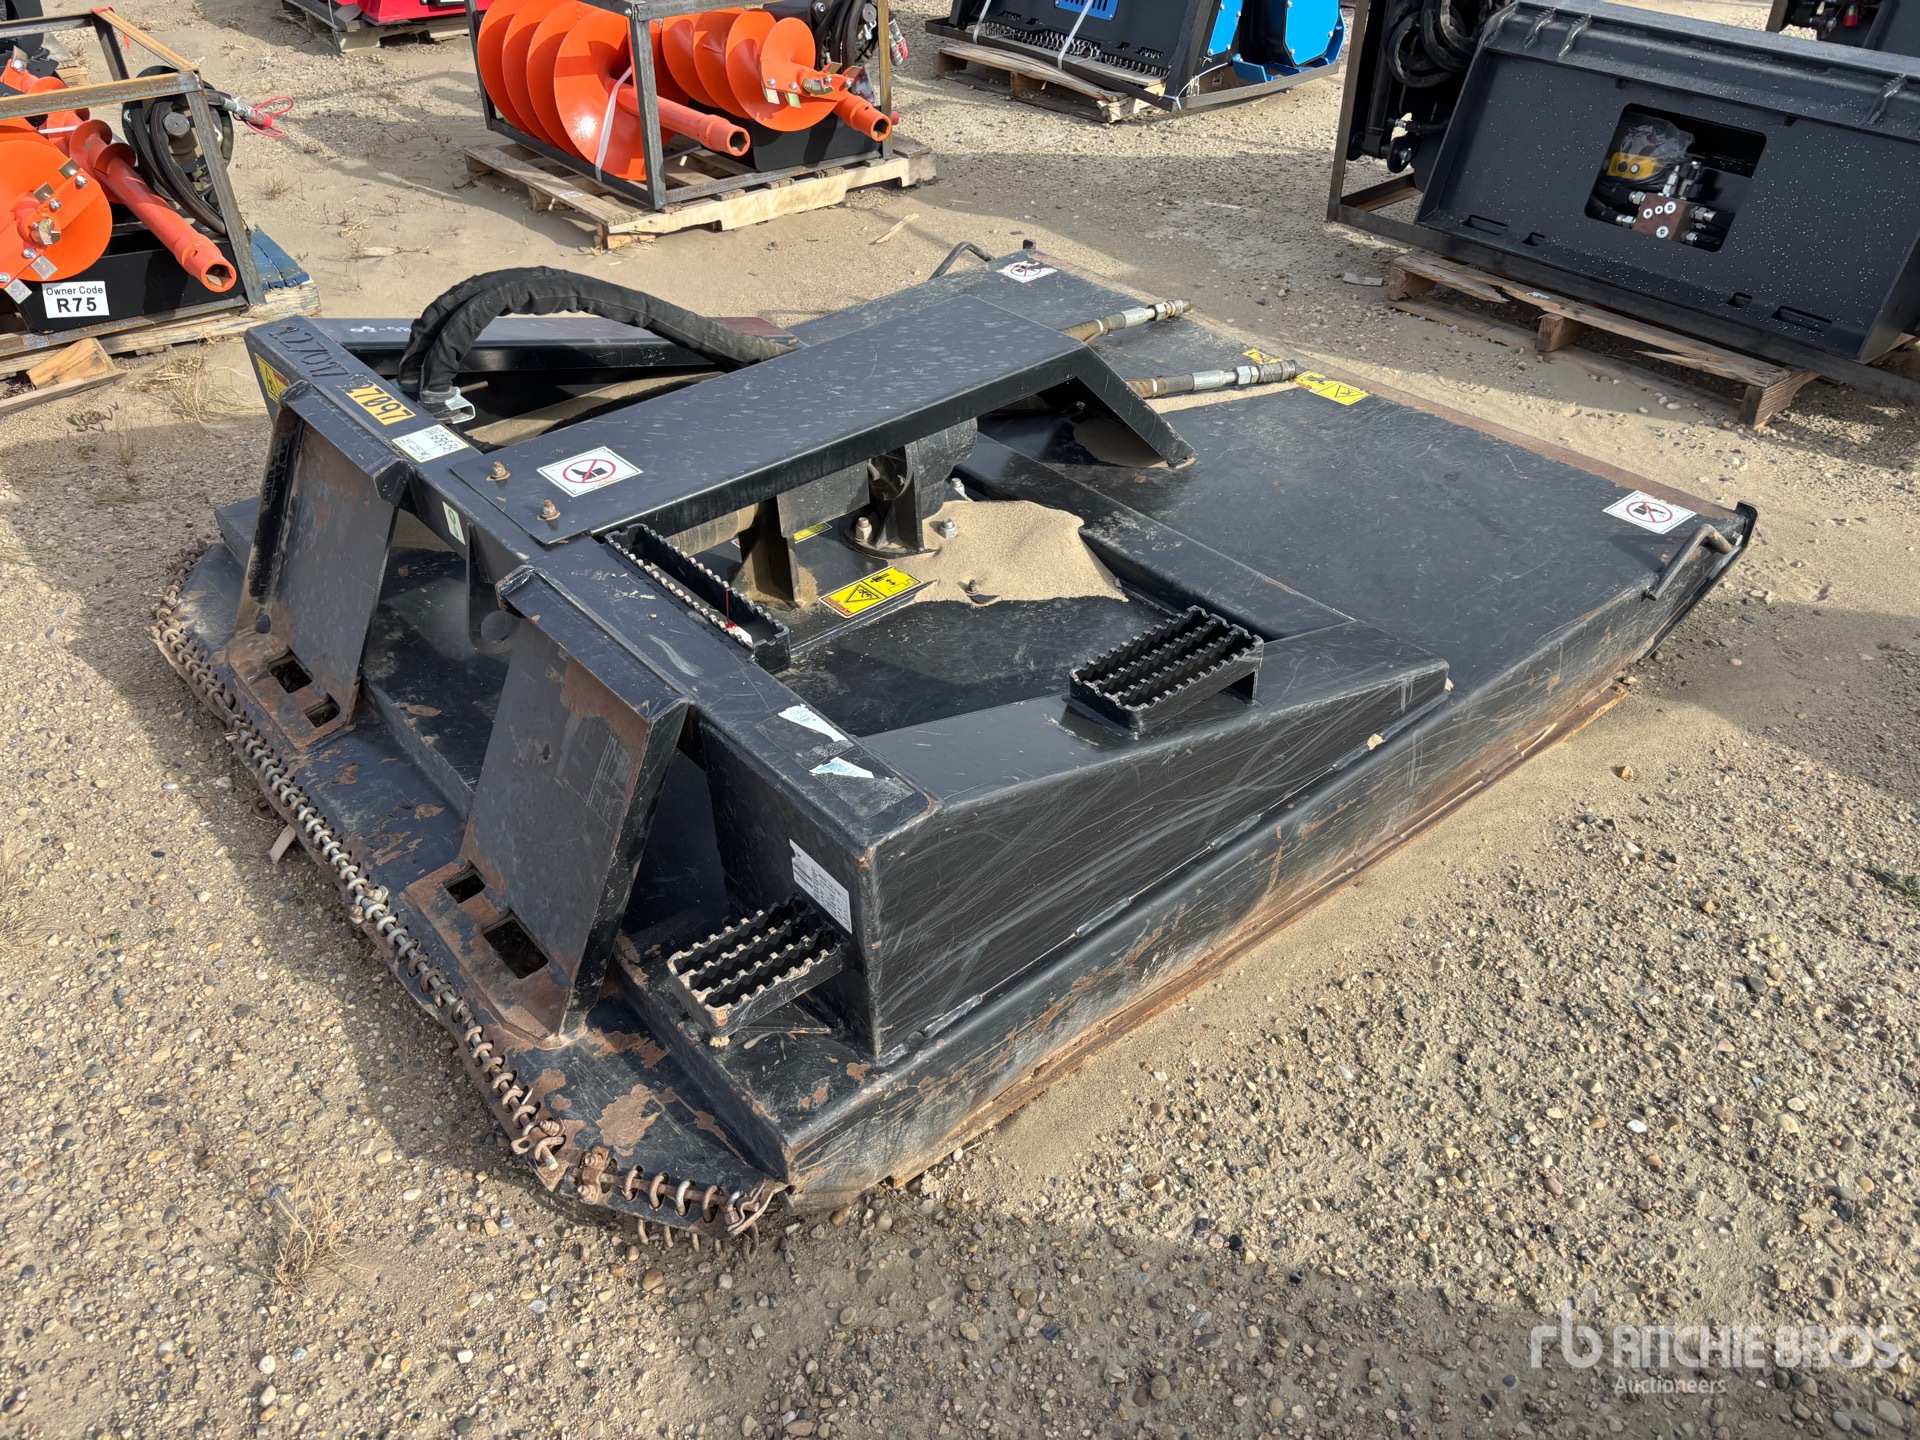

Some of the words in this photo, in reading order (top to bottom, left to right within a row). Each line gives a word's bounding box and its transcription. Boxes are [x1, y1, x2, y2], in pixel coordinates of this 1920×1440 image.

[46, 287, 76, 296] Owner
[79, 286, 104, 295] Code
[56, 297, 97, 313] R75
